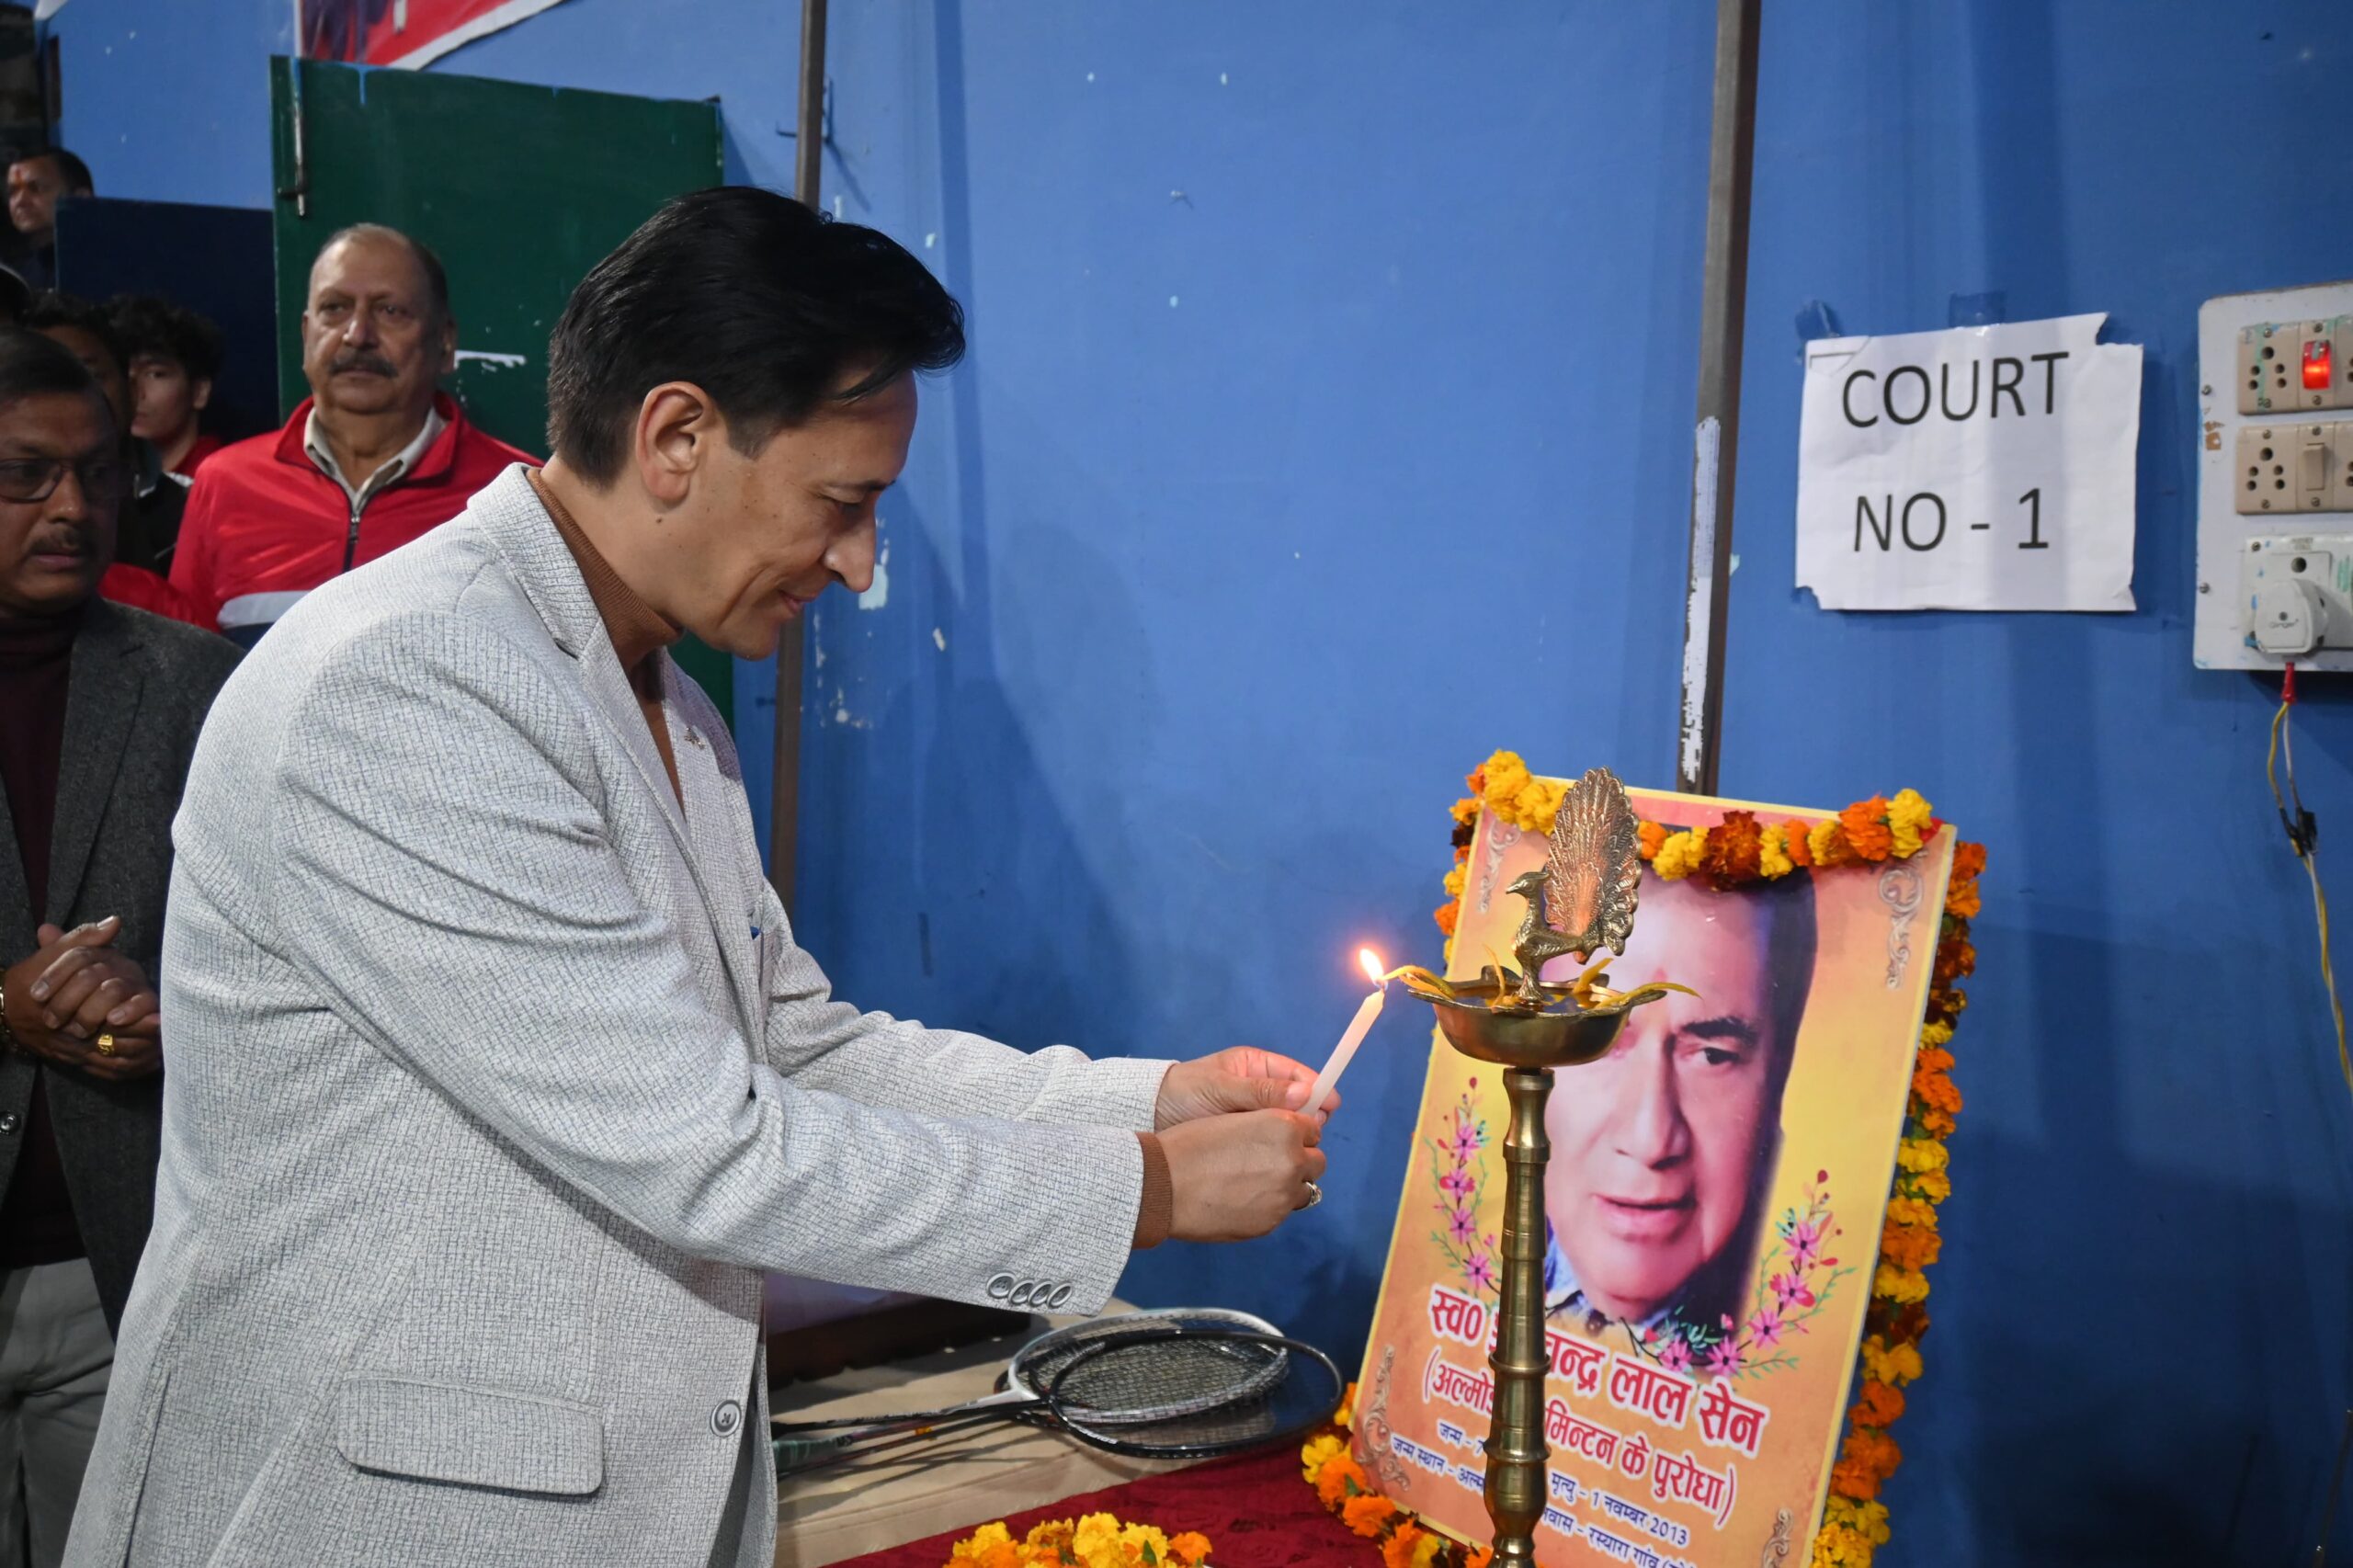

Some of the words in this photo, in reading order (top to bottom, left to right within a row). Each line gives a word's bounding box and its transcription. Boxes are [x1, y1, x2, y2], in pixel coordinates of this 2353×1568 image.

[1841, 351, 2070, 428] COURT
[1853, 492, 1948, 552] NO
[2018, 487, 2050, 551] 1
[1610, 1357, 1693, 1425] लाल
[1699, 1381, 1766, 1452] सेन
[1392, 1437, 1415, 1458] जन्म
[1417, 1448, 1446, 1472] स्थान
[1438, 1422, 1463, 1446] जन्म
[1551, 1471, 1576, 1502] मृत्यु
[1592, 1492, 1599, 1506] 1
[1604, 1494, 1648, 1527] नवम्बर
[1649, 1517, 1688, 1546] 2013
[1621, 1436, 1650, 1475] के
